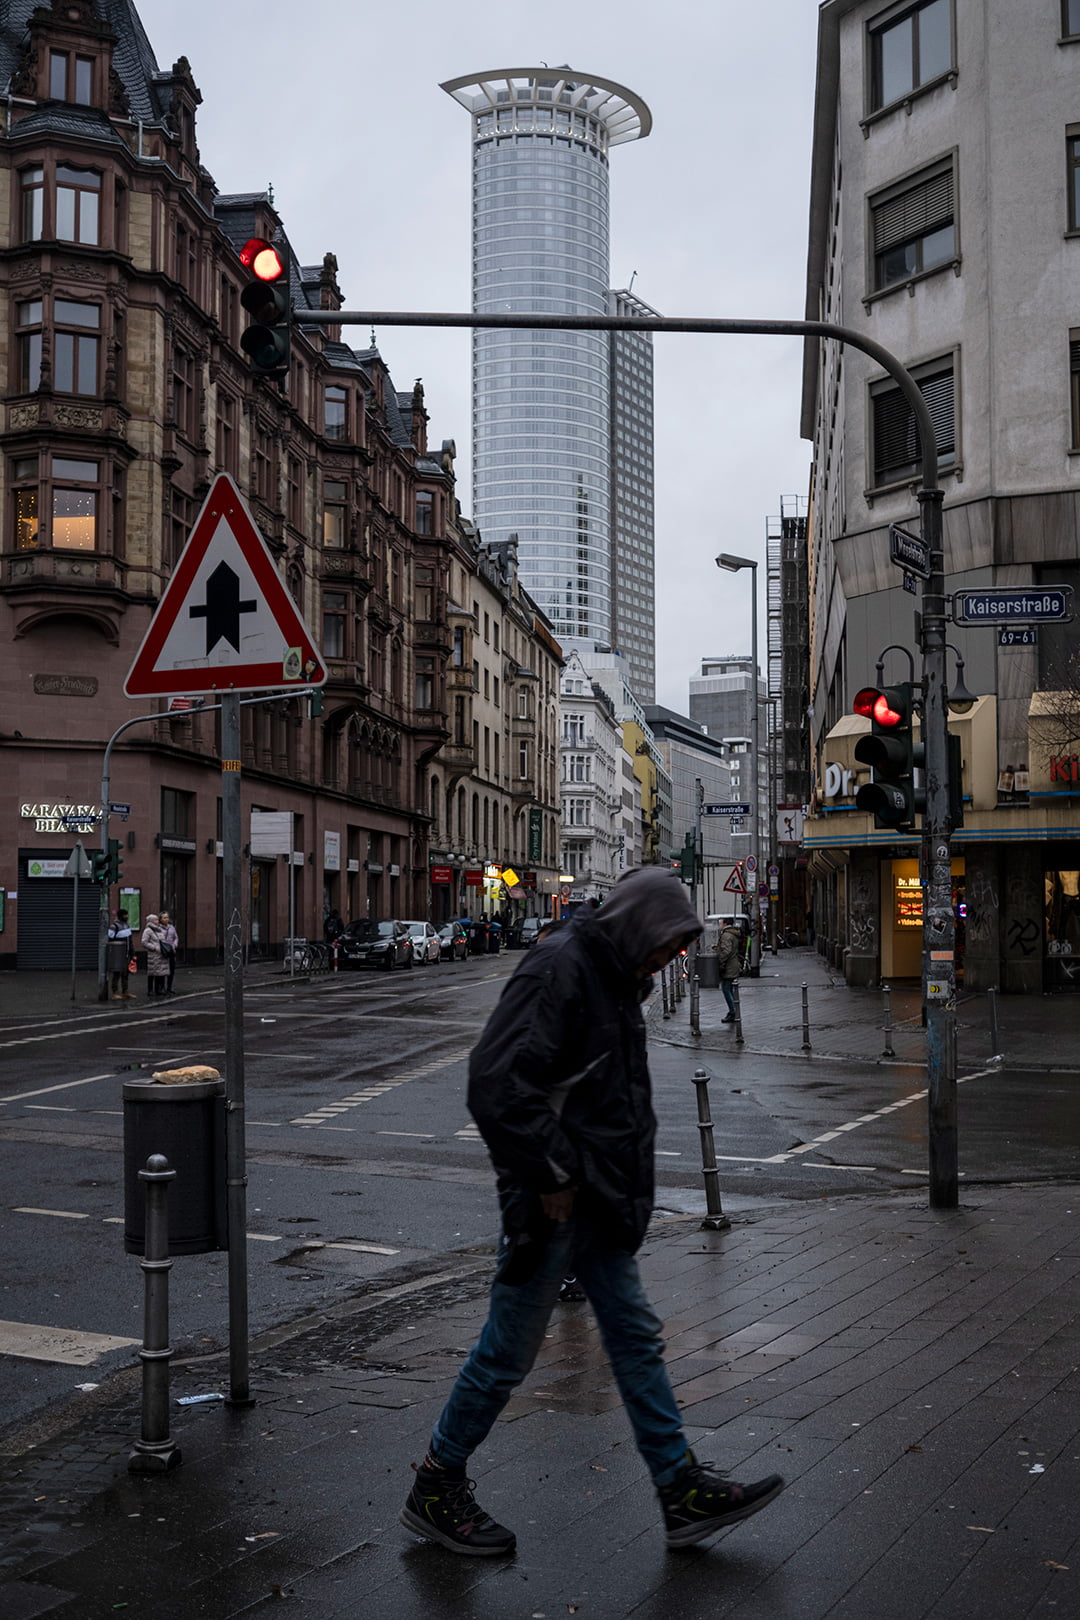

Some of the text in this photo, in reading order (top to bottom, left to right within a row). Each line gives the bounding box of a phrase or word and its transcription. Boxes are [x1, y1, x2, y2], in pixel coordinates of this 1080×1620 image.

[968, 596, 1060, 615] Kaiserstraße
[1001, 632, 1035, 644] 69-61
[825, 763, 859, 797] Dr.
